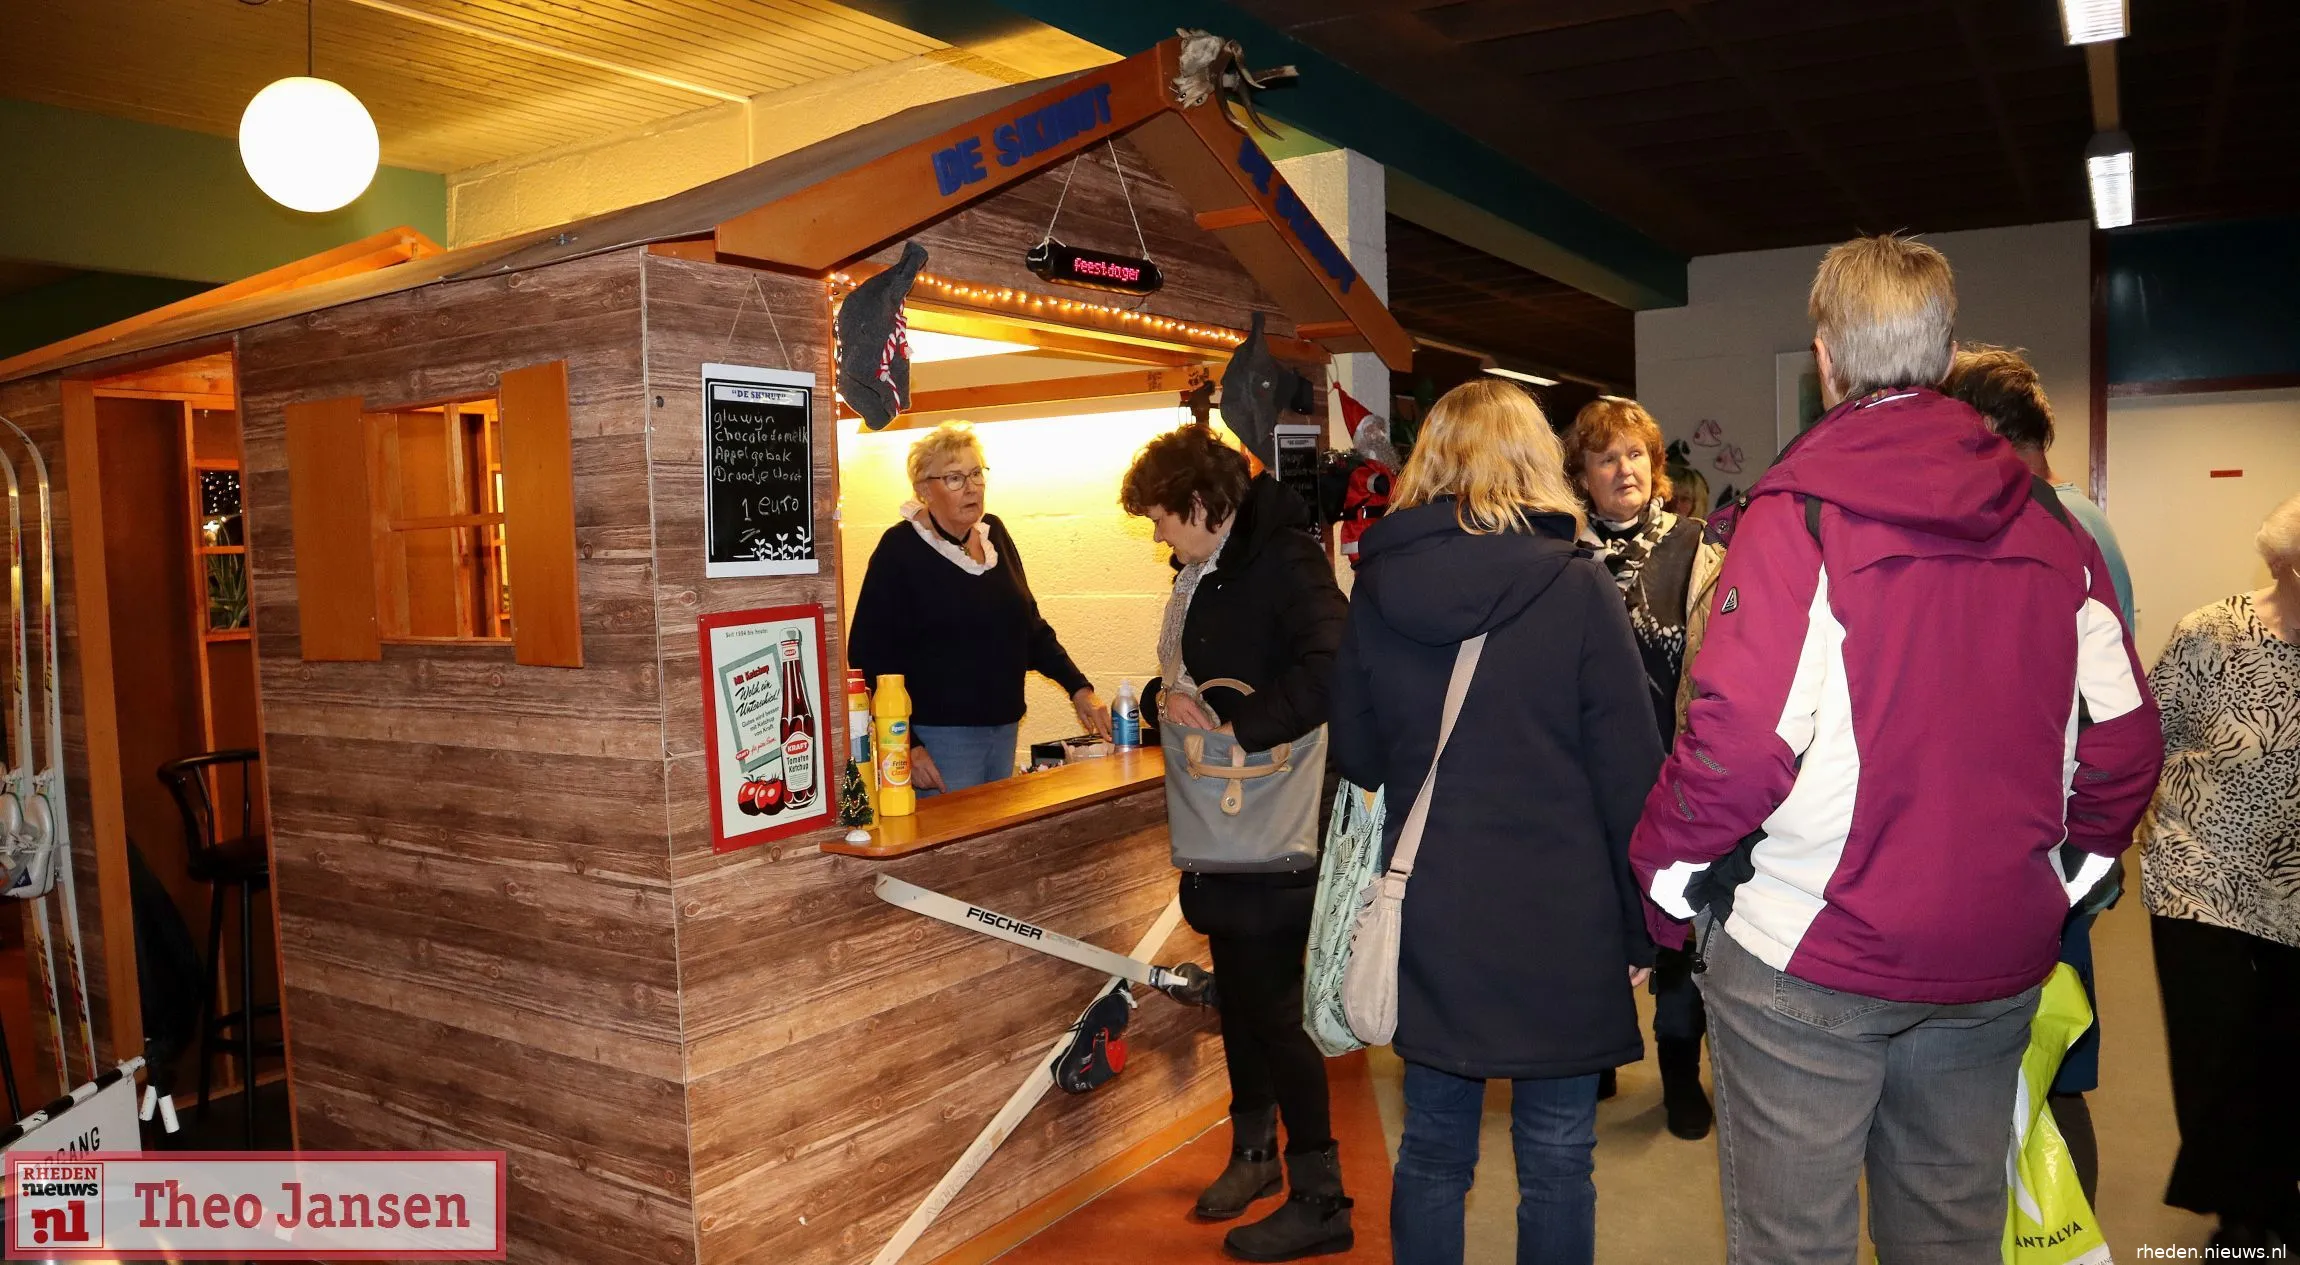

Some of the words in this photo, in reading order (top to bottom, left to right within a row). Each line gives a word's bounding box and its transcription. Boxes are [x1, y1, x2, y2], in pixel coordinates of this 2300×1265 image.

[931, 136, 988, 197] DE
[741, 497, 753, 522] 1
[758, 494, 800, 516] euro
[787, 741, 809, 753] KRAFT
[786, 754, 809, 766] Tomaten
[788, 763, 809, 774] Ketchup
[966, 906, 1043, 941] FISCHER
